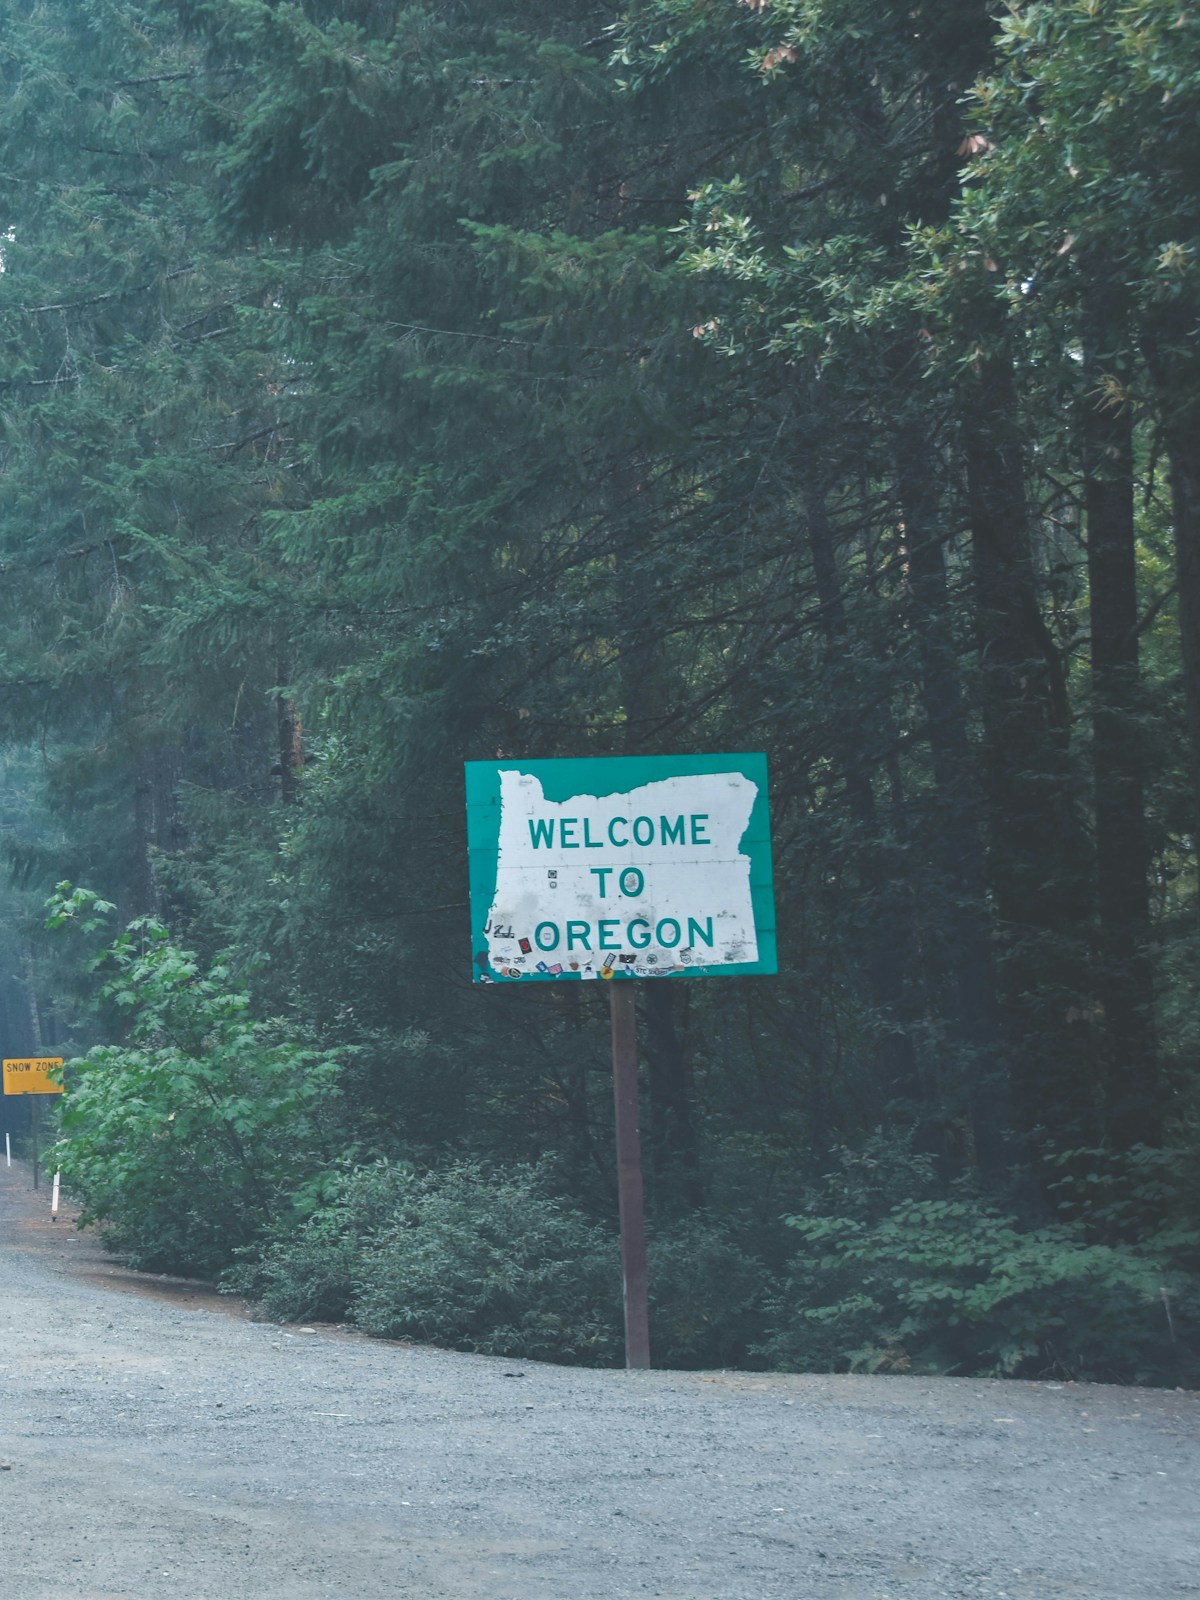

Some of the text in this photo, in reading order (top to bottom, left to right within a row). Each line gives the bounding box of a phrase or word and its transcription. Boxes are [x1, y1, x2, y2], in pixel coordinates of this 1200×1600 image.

[528, 814, 711, 849] WELCOME
[590, 867, 645, 898] TO
[534, 917, 714, 952] OREGON
[6, 1062, 31, 1073] SNOW
